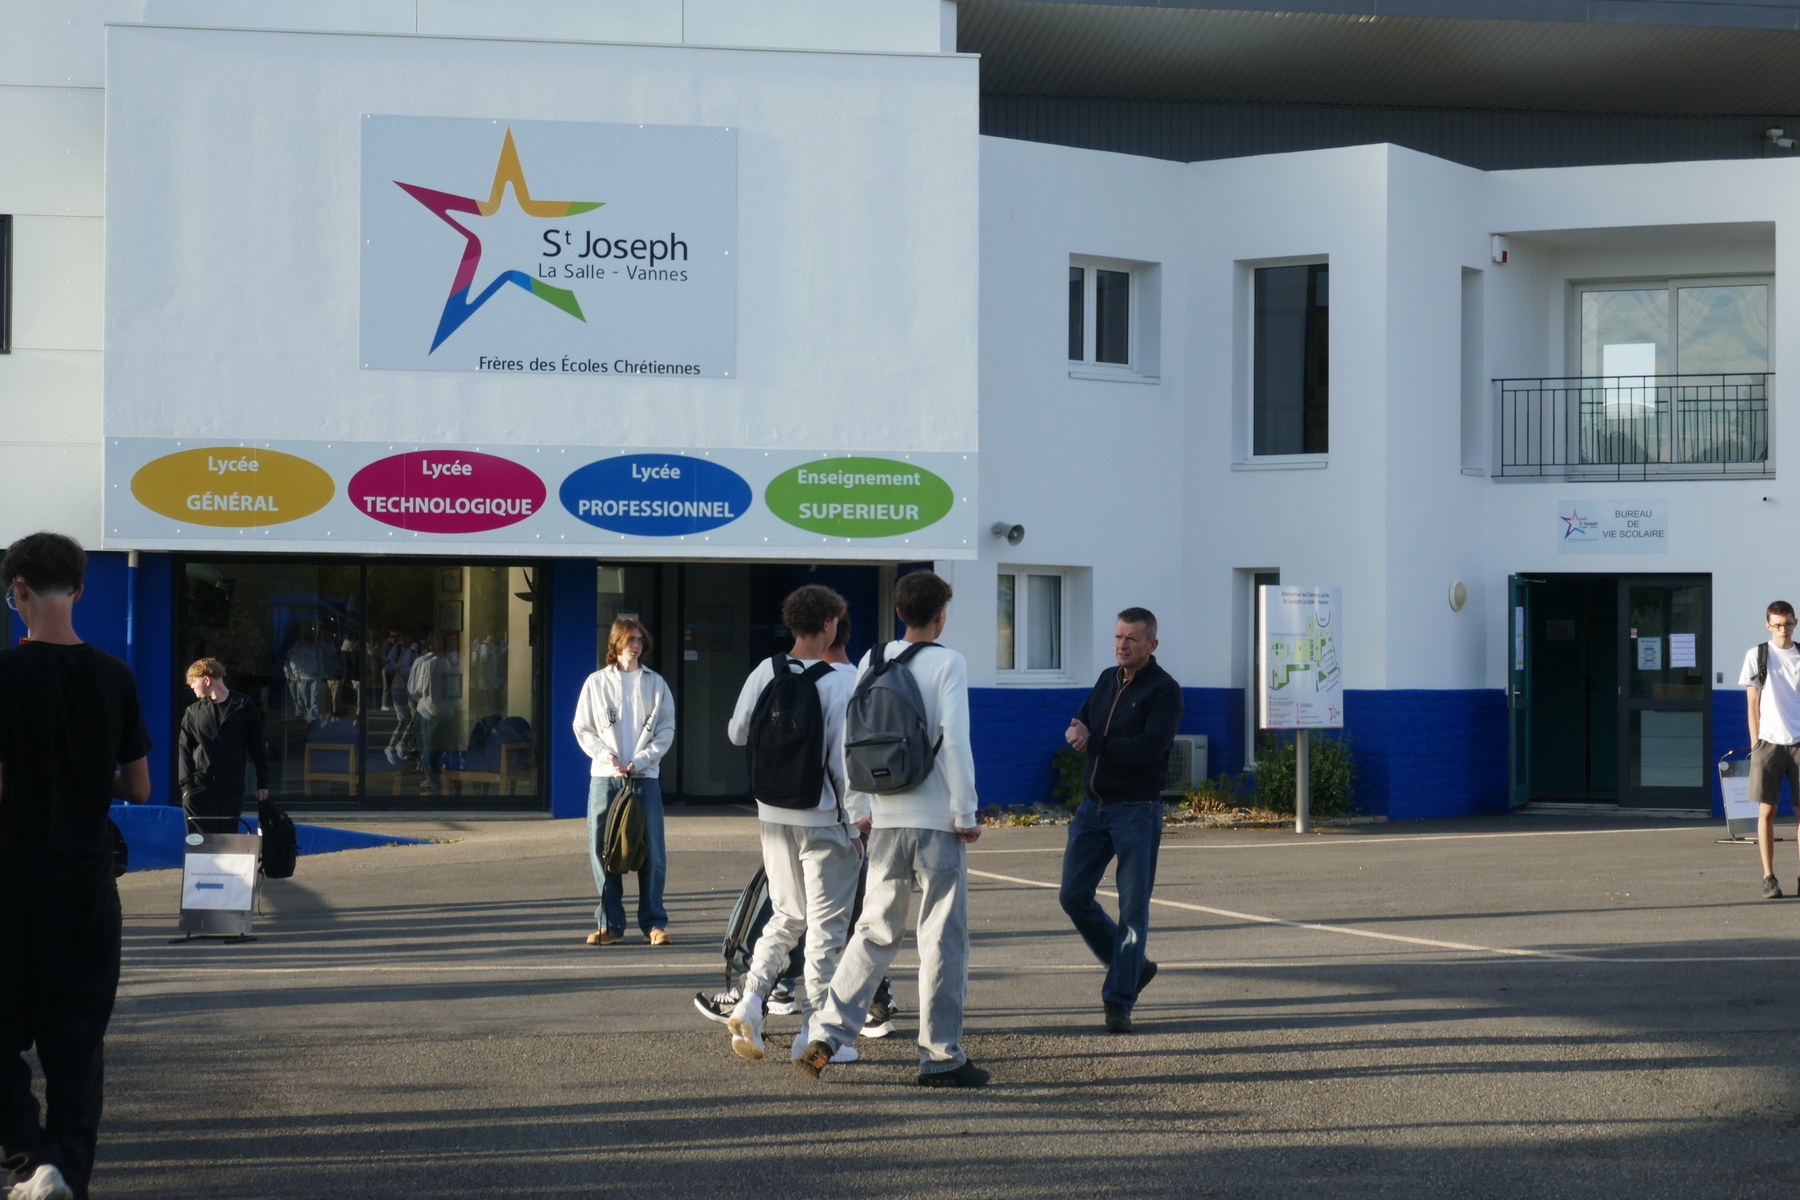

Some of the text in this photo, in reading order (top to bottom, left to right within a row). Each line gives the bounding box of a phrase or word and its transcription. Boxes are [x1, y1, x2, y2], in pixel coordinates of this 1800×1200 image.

[542, 229, 688, 267] St Joseph
[538, 263, 557, 278] La
[564, 264, 605, 280] Salle
[626, 265, 688, 282] Vannes
[479, 354, 701, 376] Frères des Écoles Chrétiennes
[208, 456, 260, 474] Lycée
[422, 460, 473, 479] Lycée
[631, 463, 681, 483] Lycée
[797, 469, 921, 488] Enseignement
[186, 493, 280, 512] GÉNÉRAL
[363, 496, 533, 517] TECHNOLOGIQUE
[578, 500, 735, 518] PROFESSIONNEL
[798, 502, 920, 520] SUPERIEUR
[1615, 510, 1652, 518] BUREAU
[1627, 520, 1640, 528] DE
[1602, 530, 1664, 538] VIE SCOLAIRE
